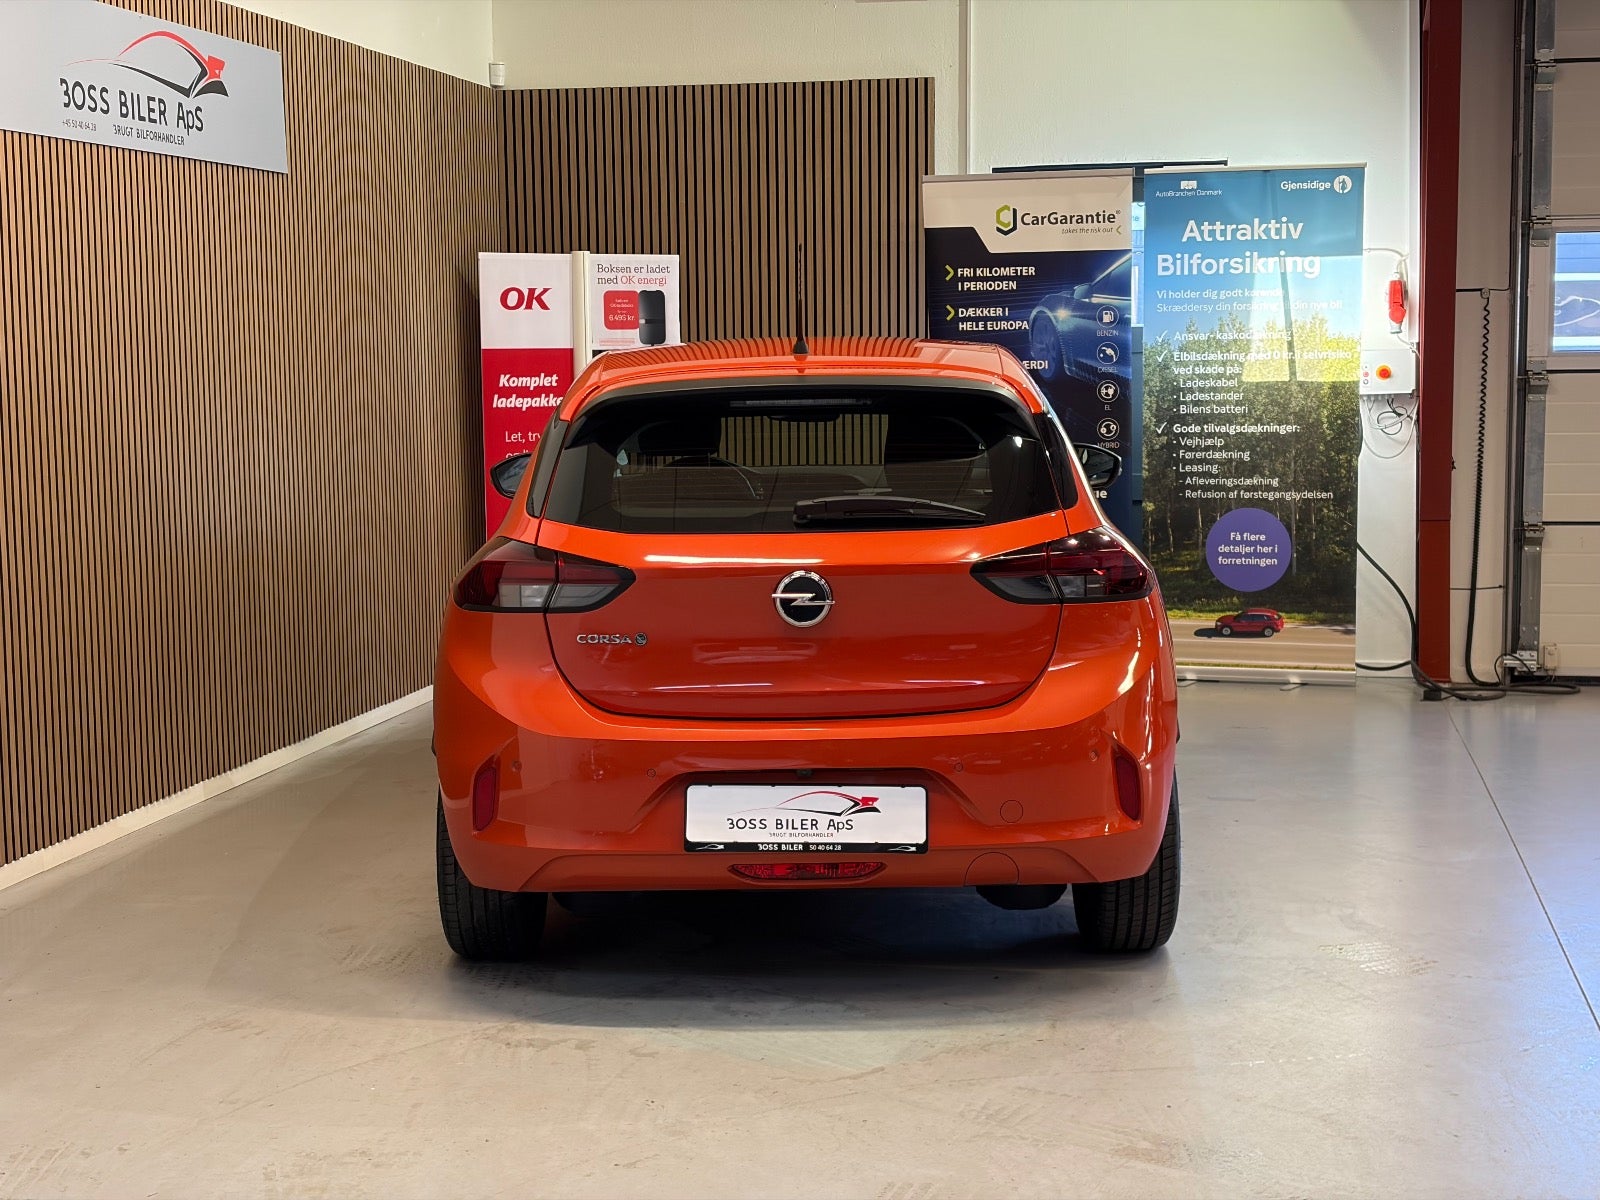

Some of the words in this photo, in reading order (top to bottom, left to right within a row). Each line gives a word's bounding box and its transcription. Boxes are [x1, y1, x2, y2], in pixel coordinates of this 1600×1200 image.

[118, 89, 168, 126] BILER
[176, 101, 204, 136] ApS
[136, 128, 185, 146] BILFORHANDLER
[1280, 180, 1331, 191] Gjensidige
[1155, 190, 1196, 198] AutoBranchen
[1061, 227, 1078, 235] takes
[1079, 226, 1089, 234] the
[1090, 226, 1101, 234] risk
[1181, 216, 1304, 242] Attraktiv
[597, 263, 632, 274] Boksen
[633, 265, 645, 274] er
[646, 264, 671, 274] ladet
[1156, 250, 1321, 279] Bilforsikring
[957, 268, 974, 278] FRI
[976, 266, 1036, 277] KILOMETER
[597, 275, 618, 285] med
[620, 275, 636, 285] OK
[637, 275, 667, 287] energi
[958, 282, 962, 291] I
[963, 280, 1017, 291] PERIODEN
[500, 287, 552, 311] OK
[1156, 290, 1167, 299] Vi
[1168, 289, 1201, 299] holder
[1202, 288, 1218, 300] dig
[1219, 288, 1244, 299] godt
[958, 307, 1003, 318] DÆKKER
[1005, 307, 1009, 316] I
[1156, 302, 1214, 314] Skræddersy
[1215, 302, 1231, 311] din
[1311, 302, 1328, 312] nye
[958, 321, 985, 331] HELE
[987, 319, 1030, 331] EUROPA
[1096, 329, 1119, 337] BENZIN
[1173, 330, 1214, 341] Ansvar-
[1215, 330, 1292, 342] kaskodækning
[1173, 351, 1246, 363] Elbilsdækning
[1302, 349, 1352, 360] selvrisiko
[1023, 360, 1049, 371] ÆRDI
[1173, 365, 1192, 375] ved
[1194, 365, 1225, 375] skade
[1226, 364, 1242, 377] på:
[499, 373, 559, 391] Komplet
[1179, 378, 1239, 388] Ladeskabel
[1179, 391, 1244, 401] Ladestander
[1179, 404, 1211, 414] Bilens
[1213, 404, 1249, 414] batteri
[1172, 423, 1201, 433] Gode
[1203, 423, 1301, 436] tilvalgsdækninger:
[505, 430, 526, 444] Let,
[1179, 436, 1225, 448] Vejhjælp
[1179, 450, 1251, 462] Førerdækning
[1179, 463, 1221, 474] Leasing:
[1185, 476, 1279, 488] Afleveringsdækning
[1185, 489, 1227, 499] Refusion
[1228, 489, 1239, 499] af
[1239, 489, 1334, 502] førstegangsydelsen
[1230, 531, 1241, 541] Få
[1242, 532, 1266, 541] flere
[1217, 544, 1255, 555] detaljer
[1256, 544, 1273, 553] her
[1217, 556, 1278, 568] forretningen
[576, 633, 632, 645] CORSA
[775, 818, 819, 831] BILER
[826, 818, 854, 833] ApS
[781, 843, 803, 851] BILER
